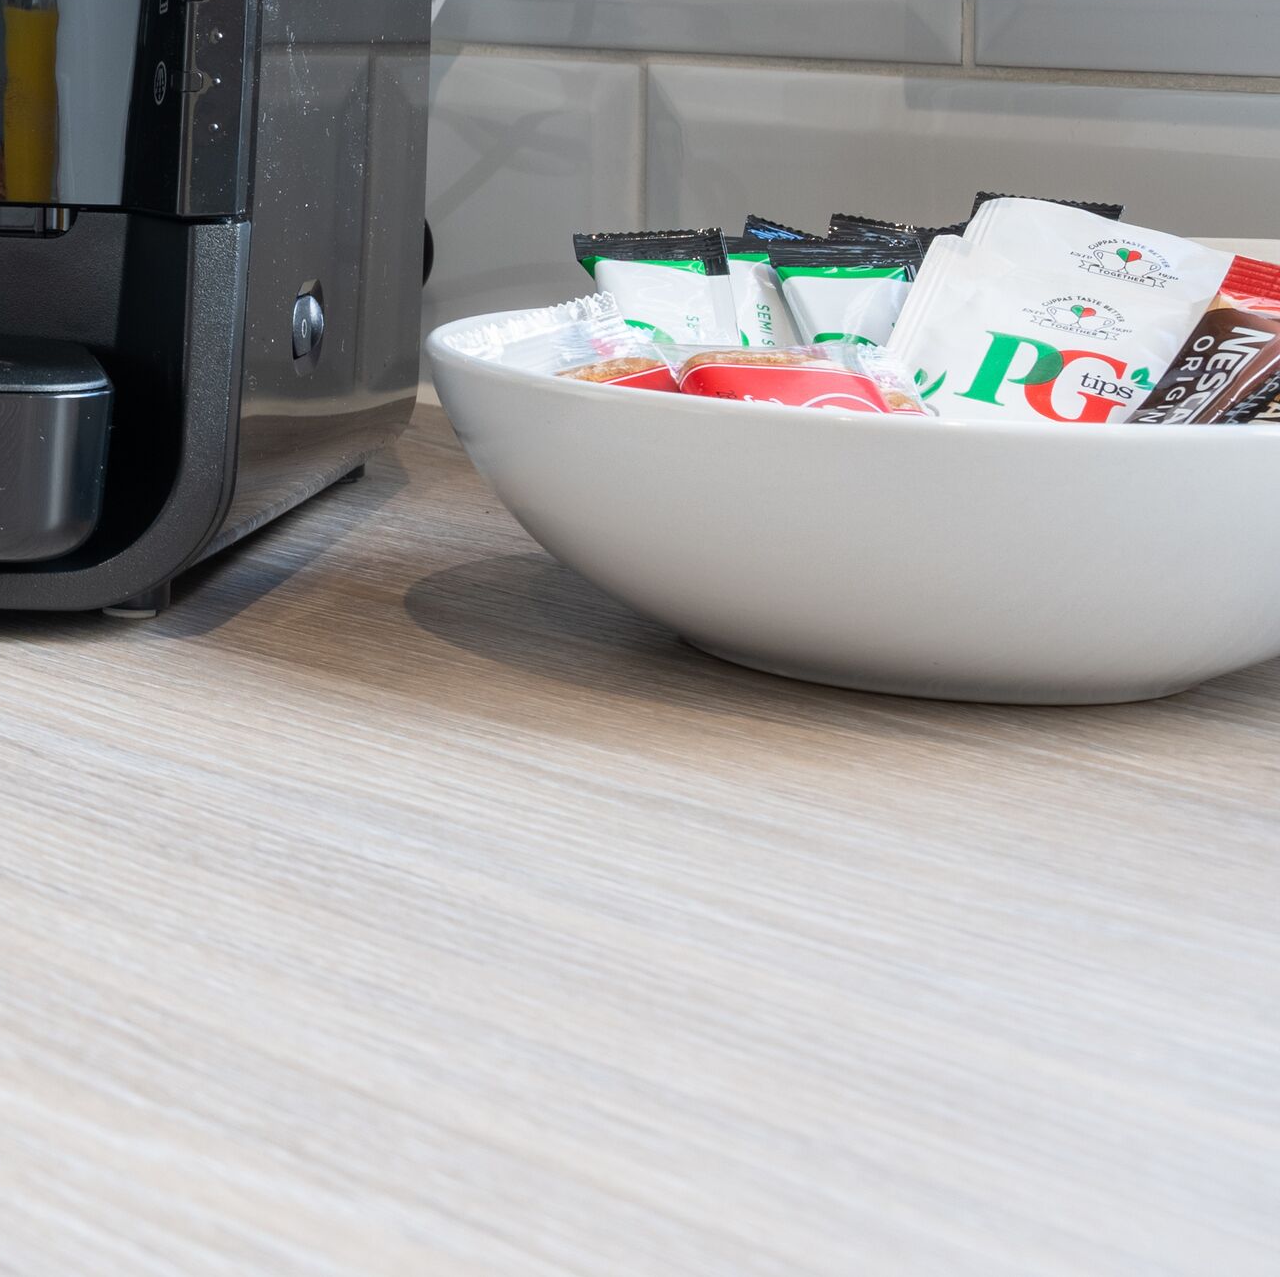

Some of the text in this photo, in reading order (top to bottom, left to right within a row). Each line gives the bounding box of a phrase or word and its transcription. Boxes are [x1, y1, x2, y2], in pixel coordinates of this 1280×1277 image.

[1088, 238, 1171, 269] CUPPAS TASTE BETTER
[1098, 269, 1146, 284] TOGETHER
[757, 304, 774, 335] SEMI
[1041, 296, 1125, 323] CUPPAS TASTE BETTER
[1051, 323, 1099, 336] TOGETHER
[954, 330, 1133, 423] PG tips
